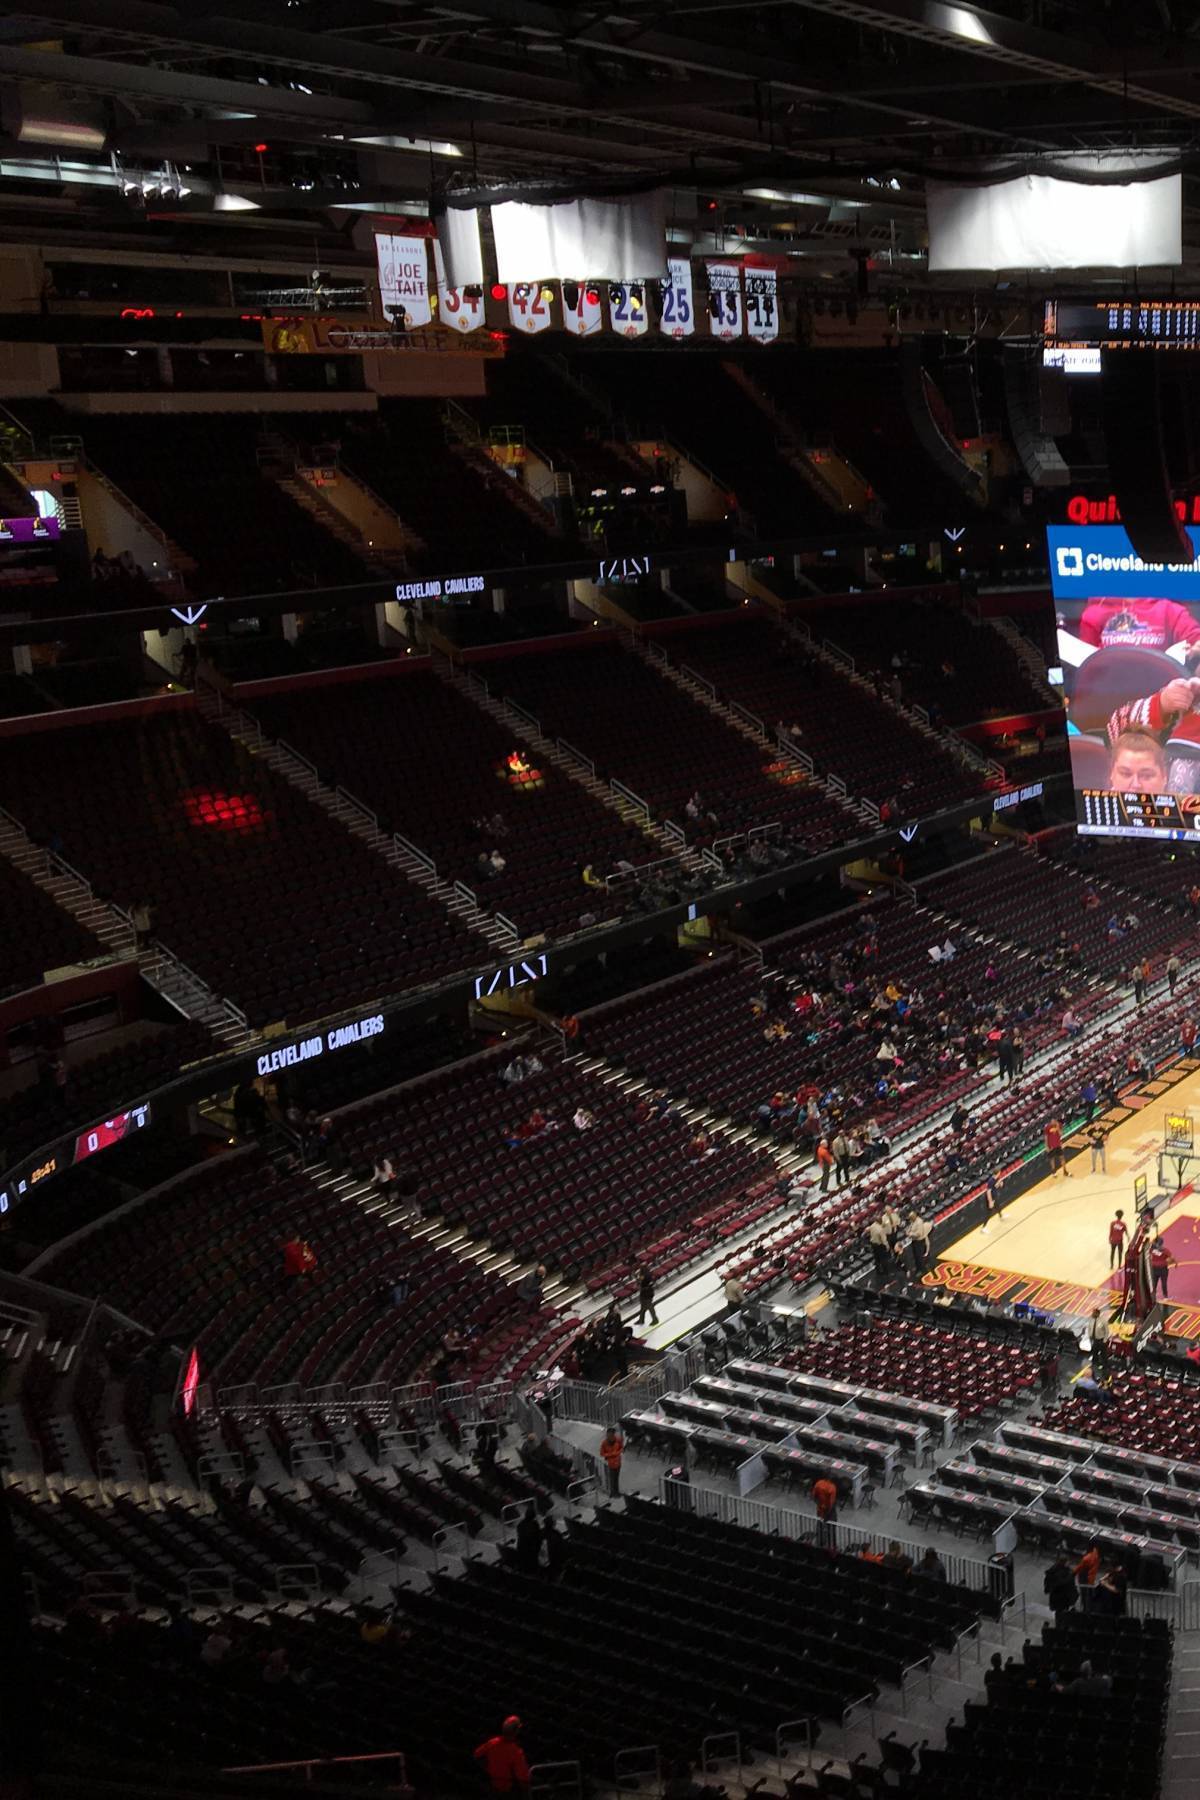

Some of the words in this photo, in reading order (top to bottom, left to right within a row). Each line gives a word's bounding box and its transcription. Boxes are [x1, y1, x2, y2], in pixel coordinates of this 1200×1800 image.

[398, 263, 422, 279] JOE
[396, 280, 425, 296] TAIT
[446, 287, 480, 314] 34
[512, 283, 545, 315] 42
[664, 288, 690, 323] 25
[1067, 496, 1187, 525] Quin
[396, 579, 442, 600] CLEVELAND
[444, 576, 485, 595] CAVALIERS
[256, 1036, 323, 1066] CLEVELAND
[327, 1014, 385, 1051] CAVALIERS
[137, 1113, 145, 1128] 0
[87, 1132, 98, 1152] 0
